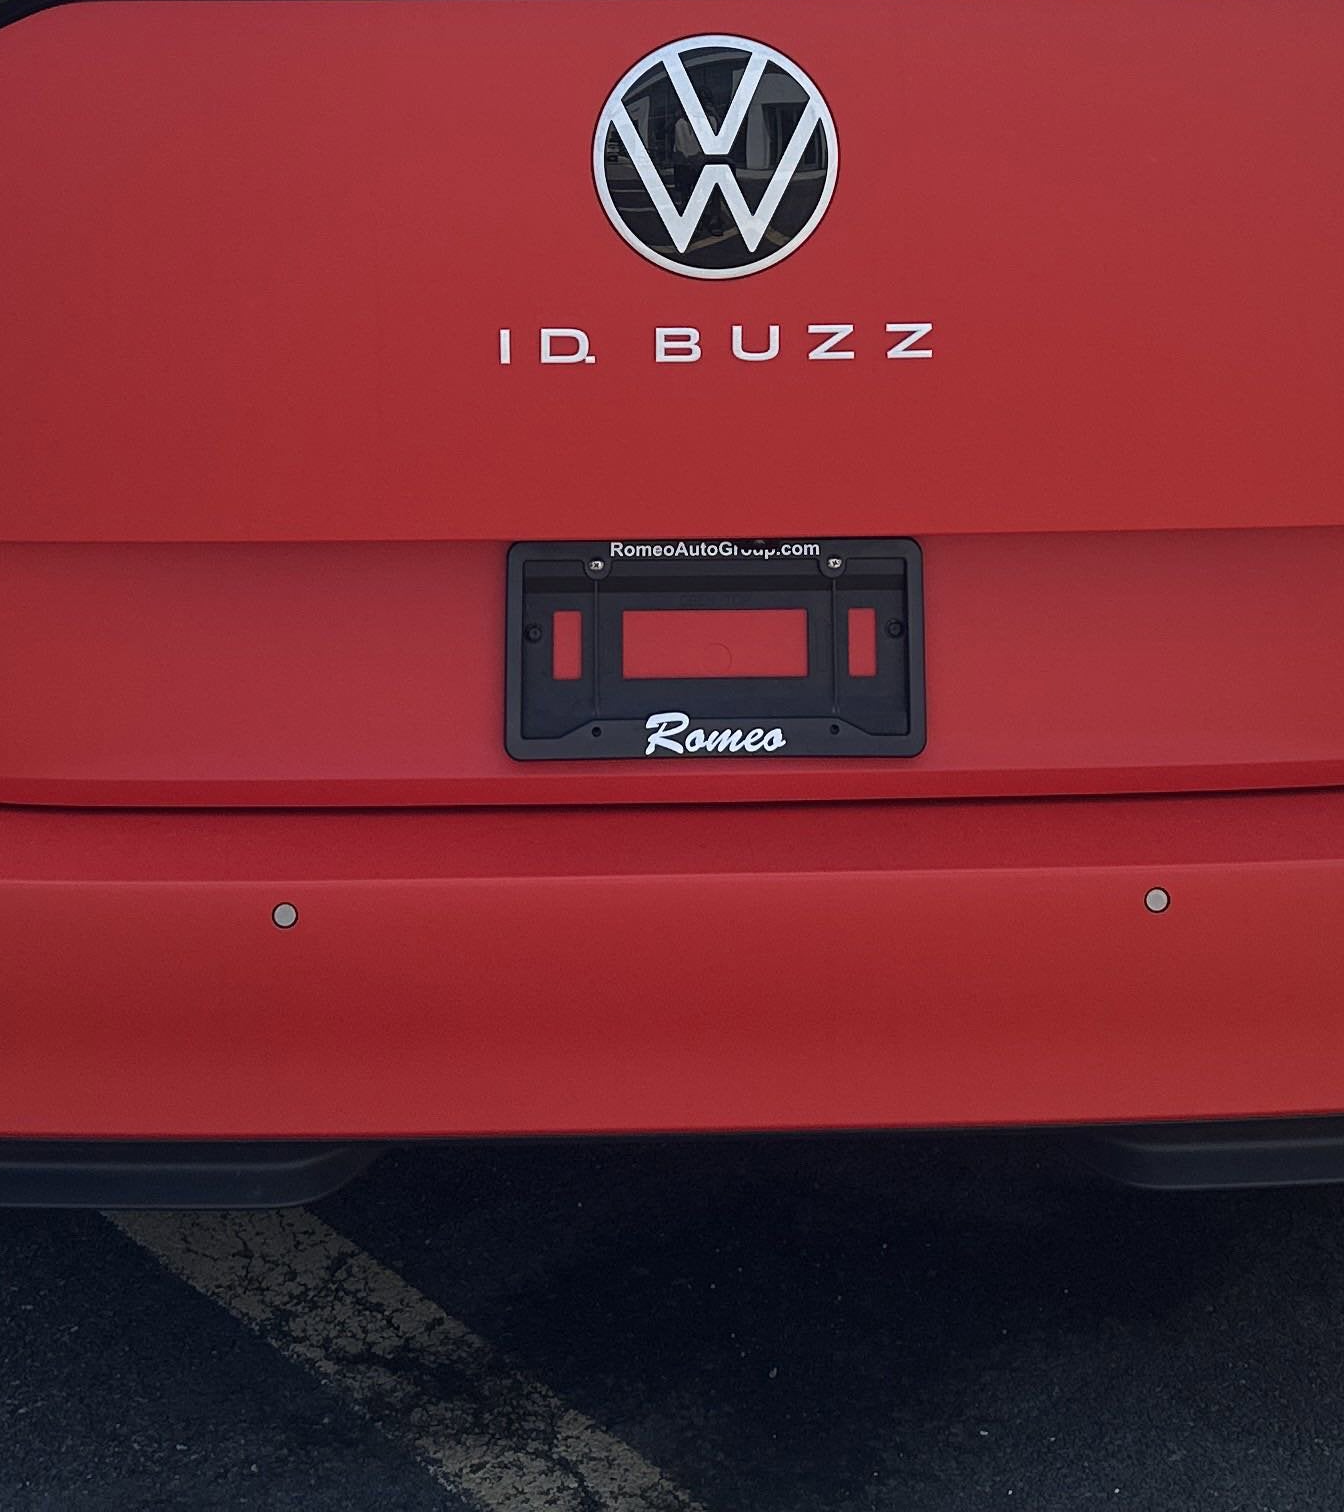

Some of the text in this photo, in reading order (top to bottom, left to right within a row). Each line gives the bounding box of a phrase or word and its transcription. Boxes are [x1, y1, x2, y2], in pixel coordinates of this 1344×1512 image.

[598, 41, 835, 272] VW
[655, 323, 934, 362] BUZZ
[645, 711, 787, 756] Romeo
